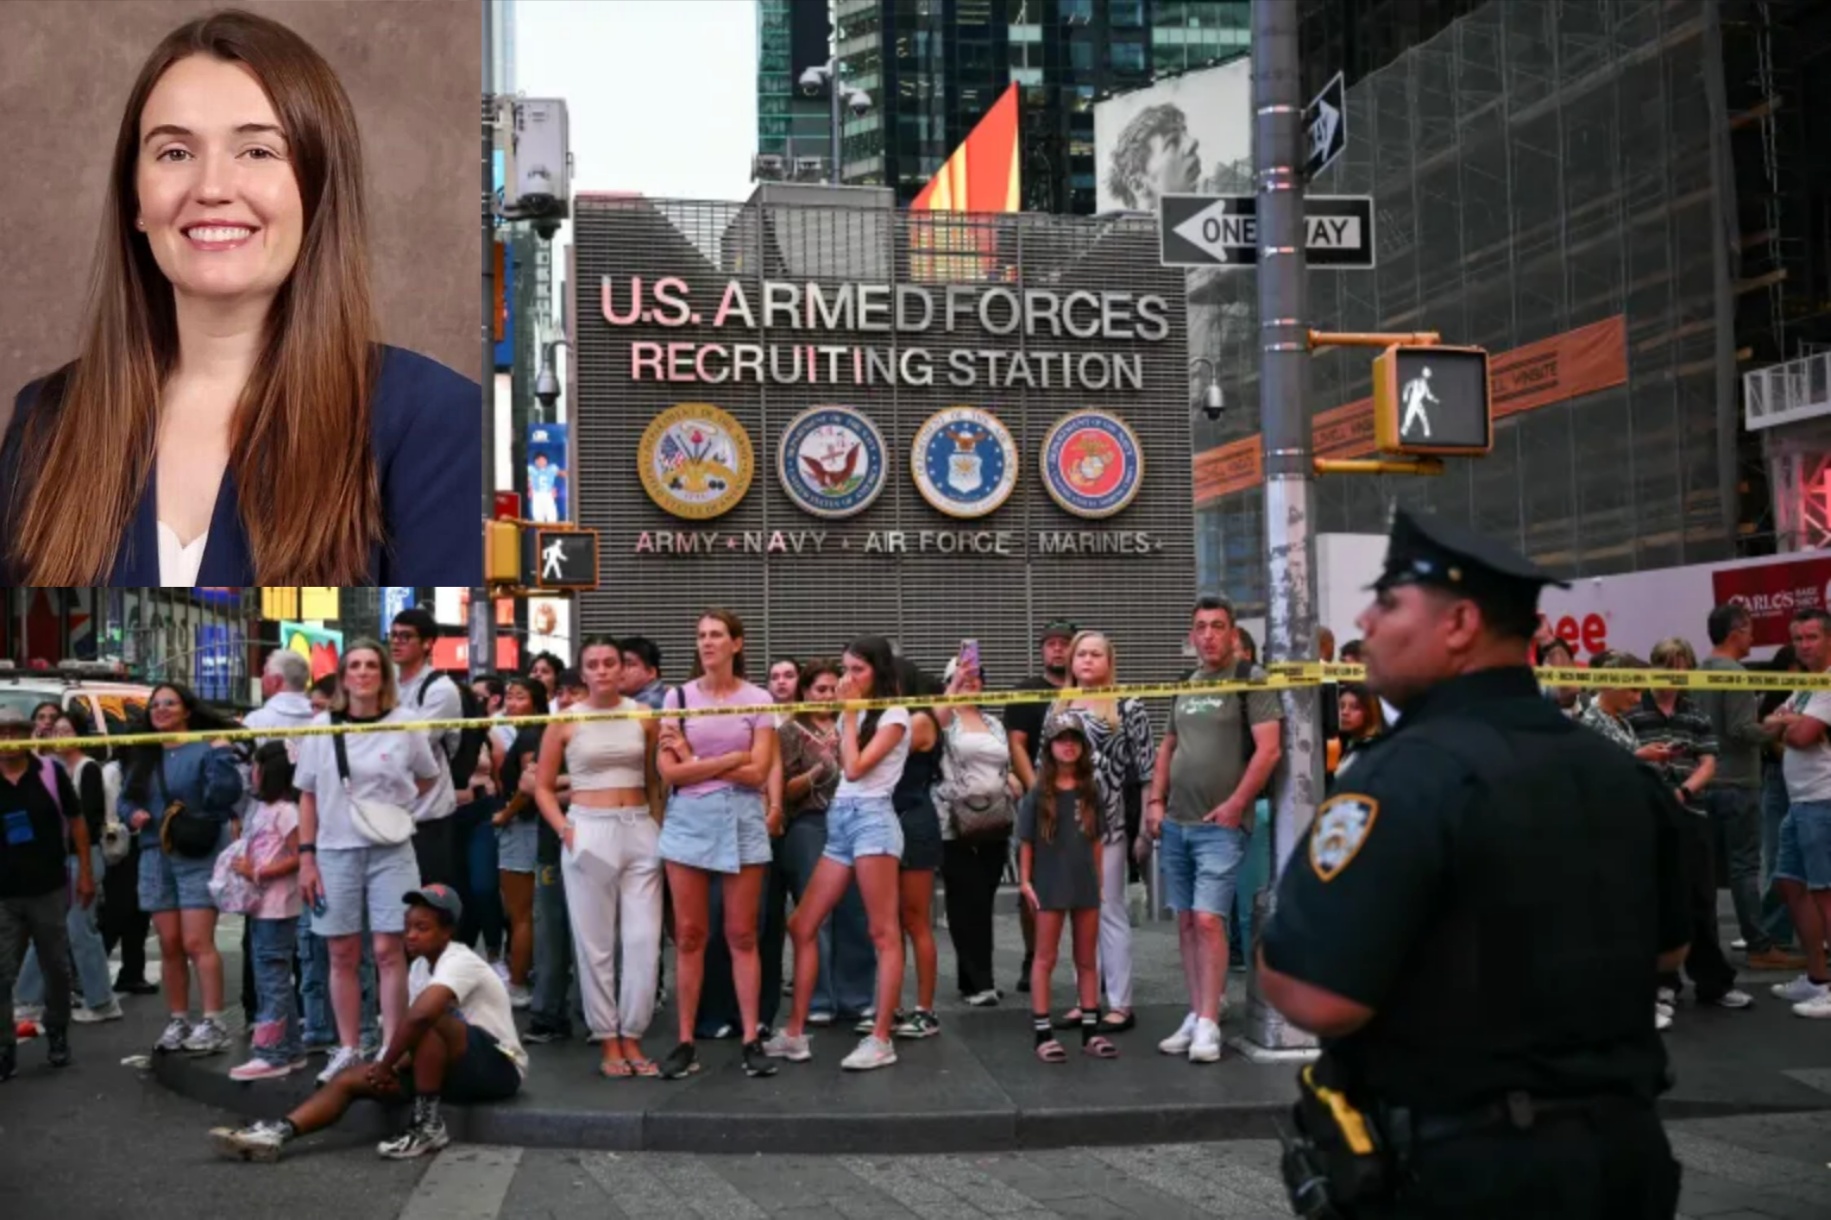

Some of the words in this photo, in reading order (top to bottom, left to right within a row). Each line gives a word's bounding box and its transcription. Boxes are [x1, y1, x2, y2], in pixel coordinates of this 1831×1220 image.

[1203, 218, 1256, 244] ONE
[1305, 219, 1348, 245] AY
[601, 275, 701, 327] U.S.
[713, 280, 933, 332] ARMED
[946, 286, 1169, 341] FORCES
[631, 341, 934, 387] RECRUITING
[948, 349, 1143, 390] STATION
[635, 530, 718, 553] ARMY
[744, 530, 827, 553] NAVY
[865, 531, 906, 553] AIR
[919, 531, 1011, 554] FORCE
[1039, 531, 1150, 554] MARINES
